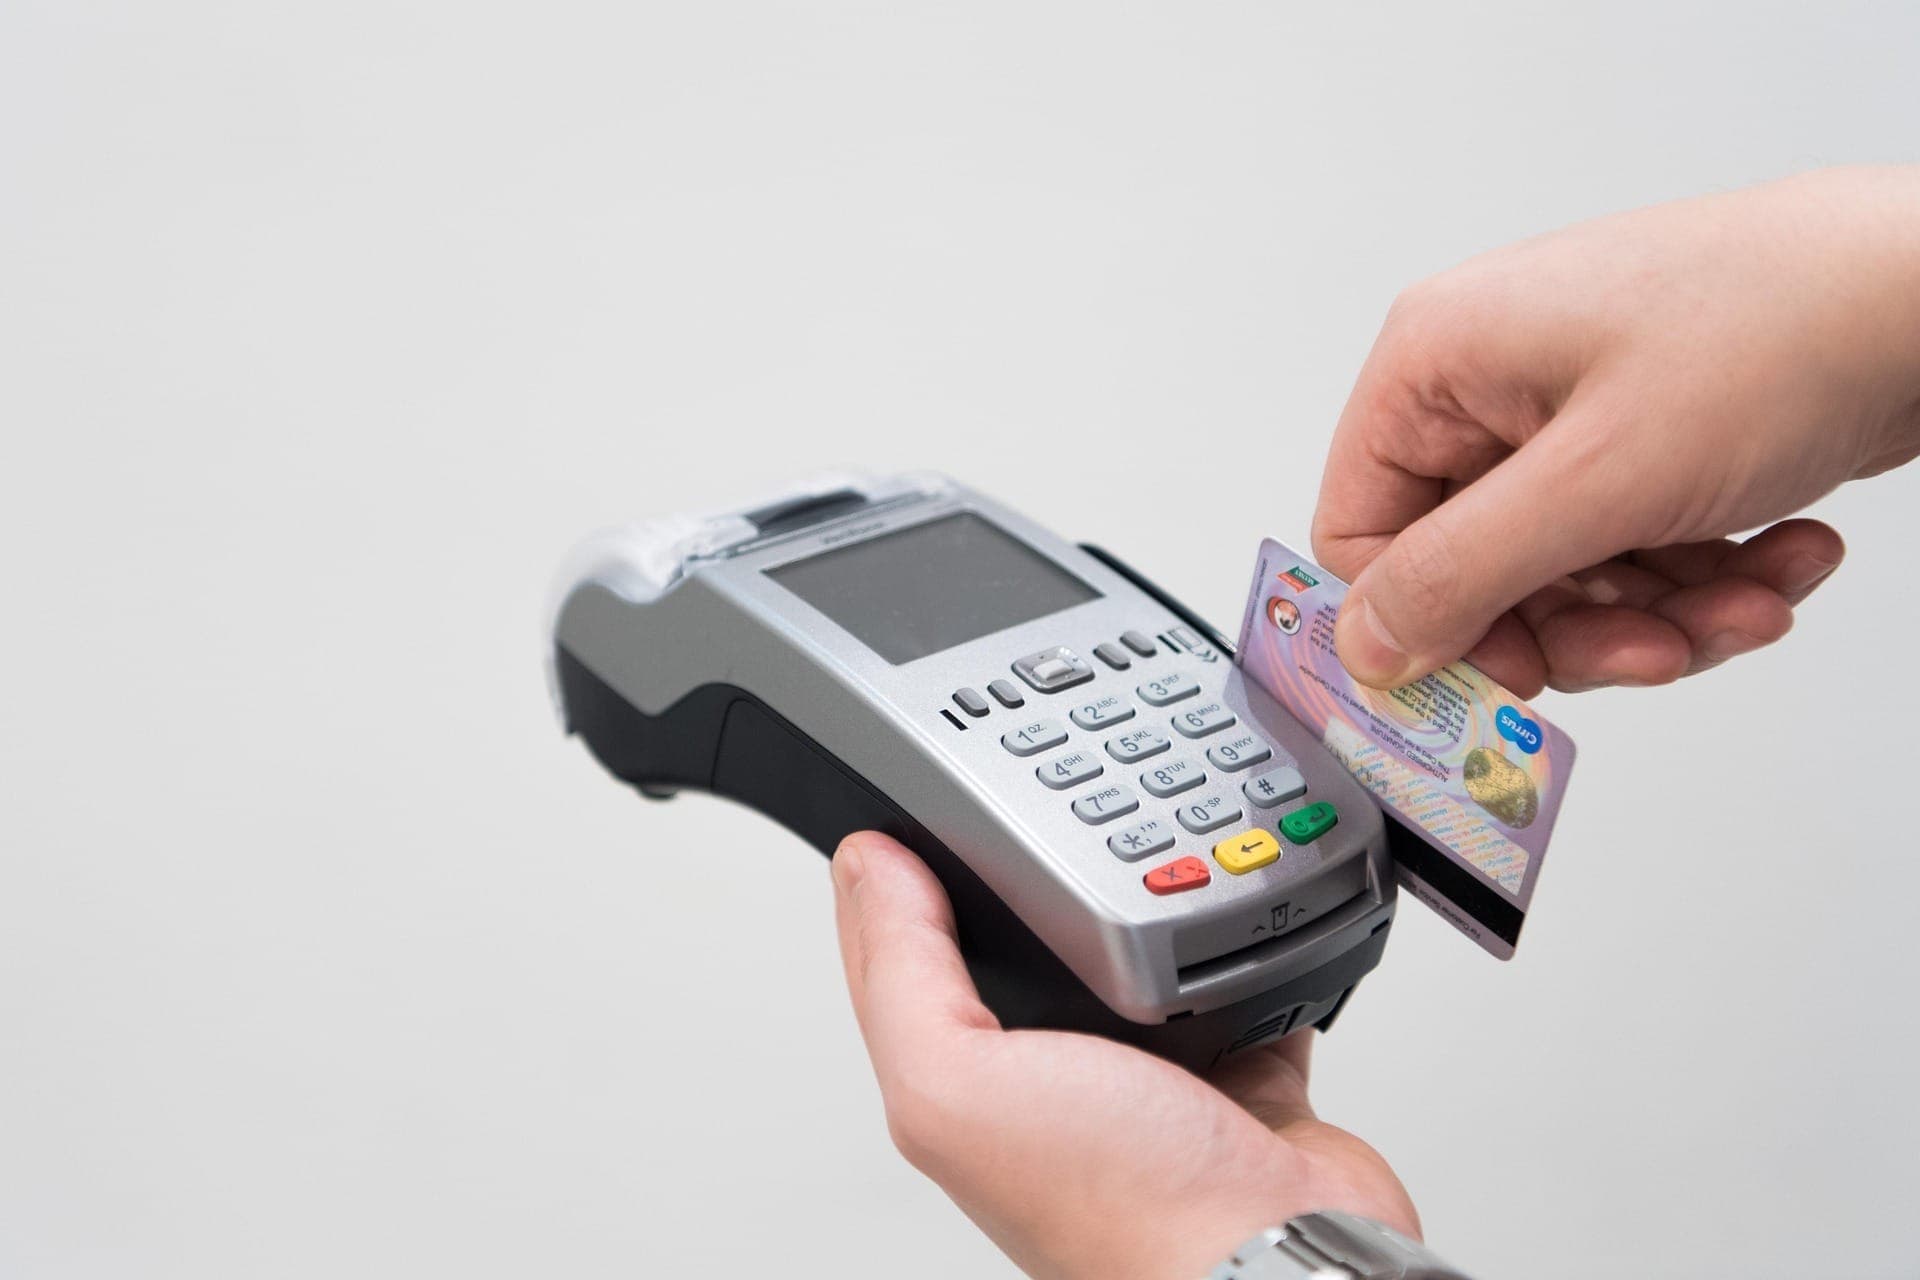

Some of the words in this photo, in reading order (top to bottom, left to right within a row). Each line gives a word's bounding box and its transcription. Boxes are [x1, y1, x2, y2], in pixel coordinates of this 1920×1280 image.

[1149, 682, 1168, 696] 3
[1162, 674, 1180, 685] DEF
[1084, 706, 1104, 720] 2
[1097, 697, 1118, 709] ABC
[1185, 713, 1204, 727] 6
[1197, 704, 1220, 716] MNO
[1018, 730, 1034, 743] 1
[1370, 724, 1405, 754] SIGNATURE
[1501, 712, 1538, 745] Cirrus
[1120, 737, 1139, 752] 5
[1133, 730, 1152, 741] JKL
[1220, 746, 1239, 760] 9
[1233, 735, 1254, 749] WXY
[1055, 762, 1071, 776] 4
[1064, 755, 1084, 767] GHI
[1154, 770, 1174, 785] 8
[1164, 761, 1186, 774] TUV
[1405, 749, 1448, 784] AUTHORISED
[1086, 796, 1103, 812] 7
[1098, 788, 1120, 800] PRS
[1191, 805, 1210, 821] 0
